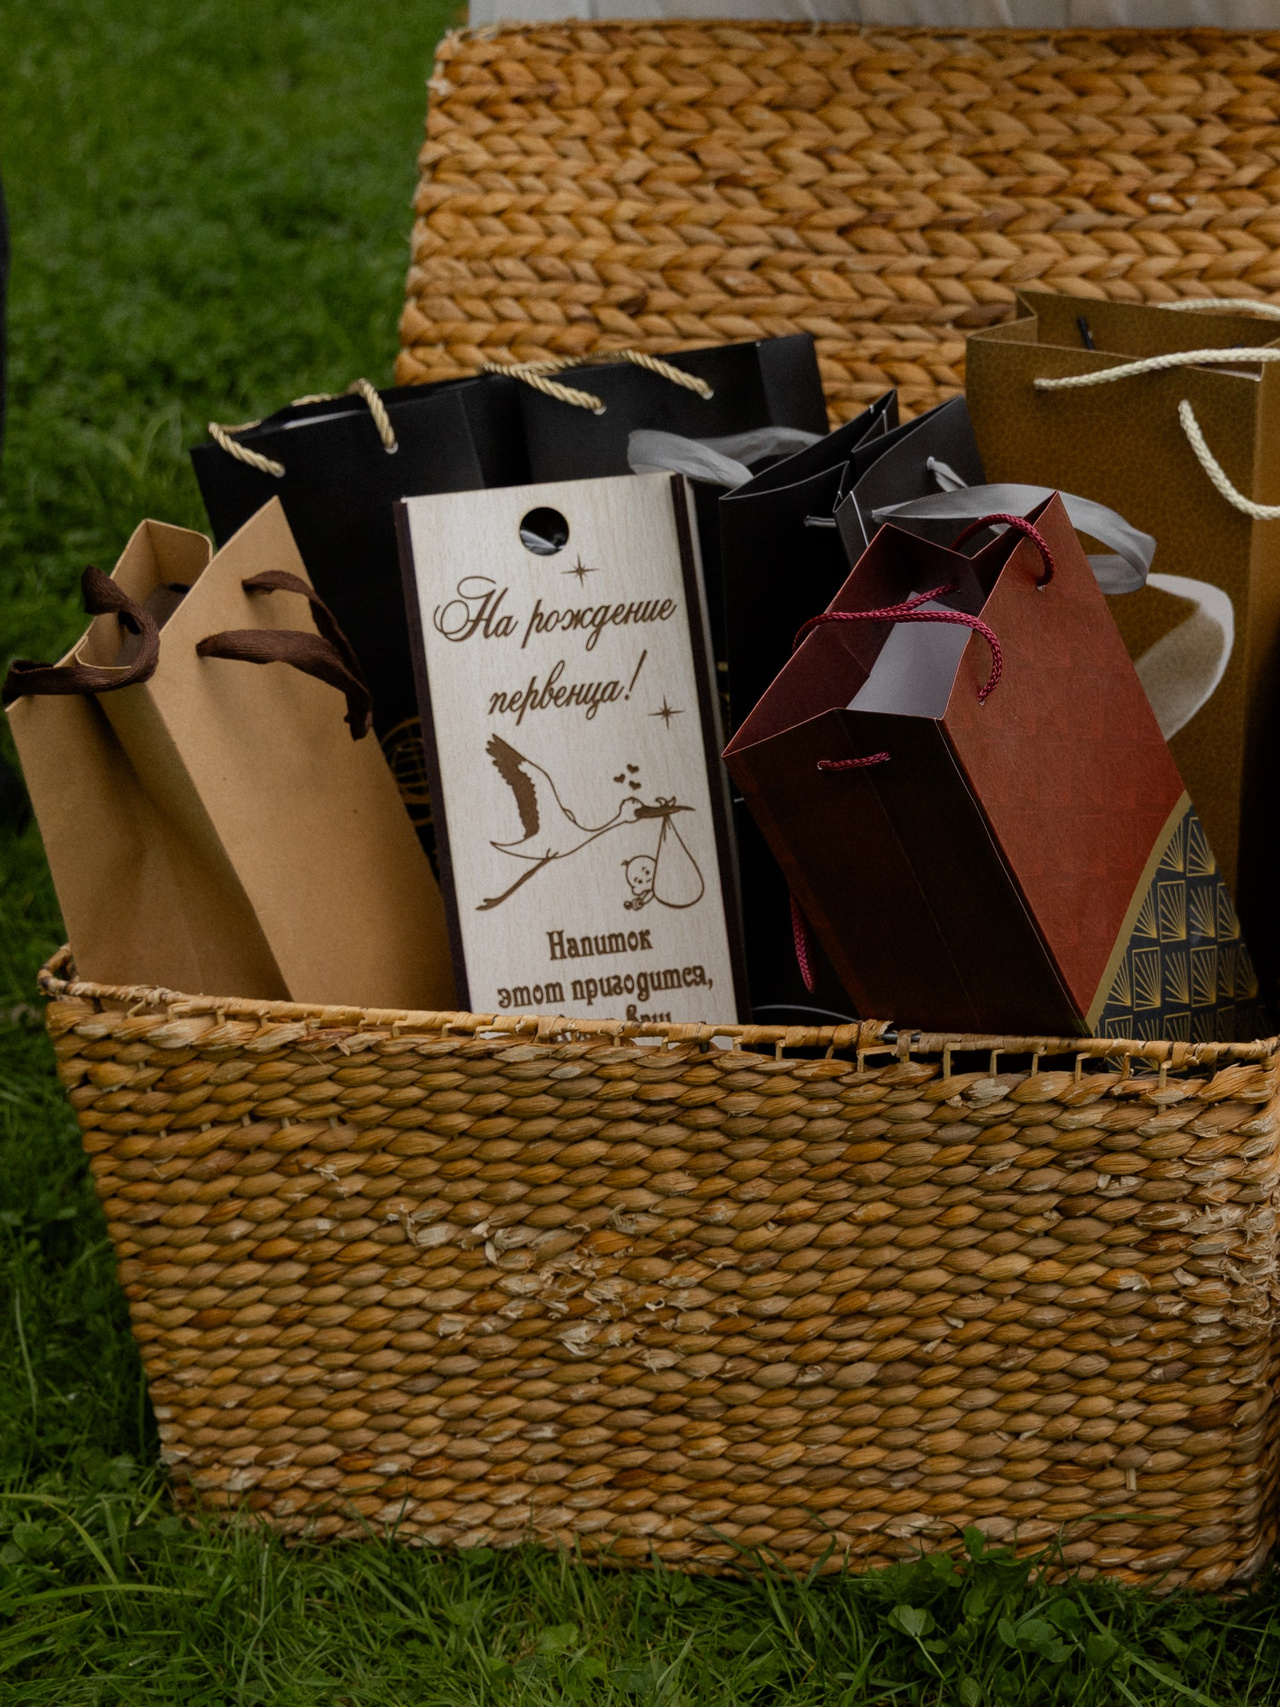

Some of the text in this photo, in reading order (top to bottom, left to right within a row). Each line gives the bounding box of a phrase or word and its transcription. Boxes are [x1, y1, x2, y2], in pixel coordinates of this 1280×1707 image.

[433, 575, 677, 651] На рождение
[488, 649, 648, 726] первенца!
[546, 929, 653, 960] Напиток
[497, 964, 714, 1009] этот пригодится,
